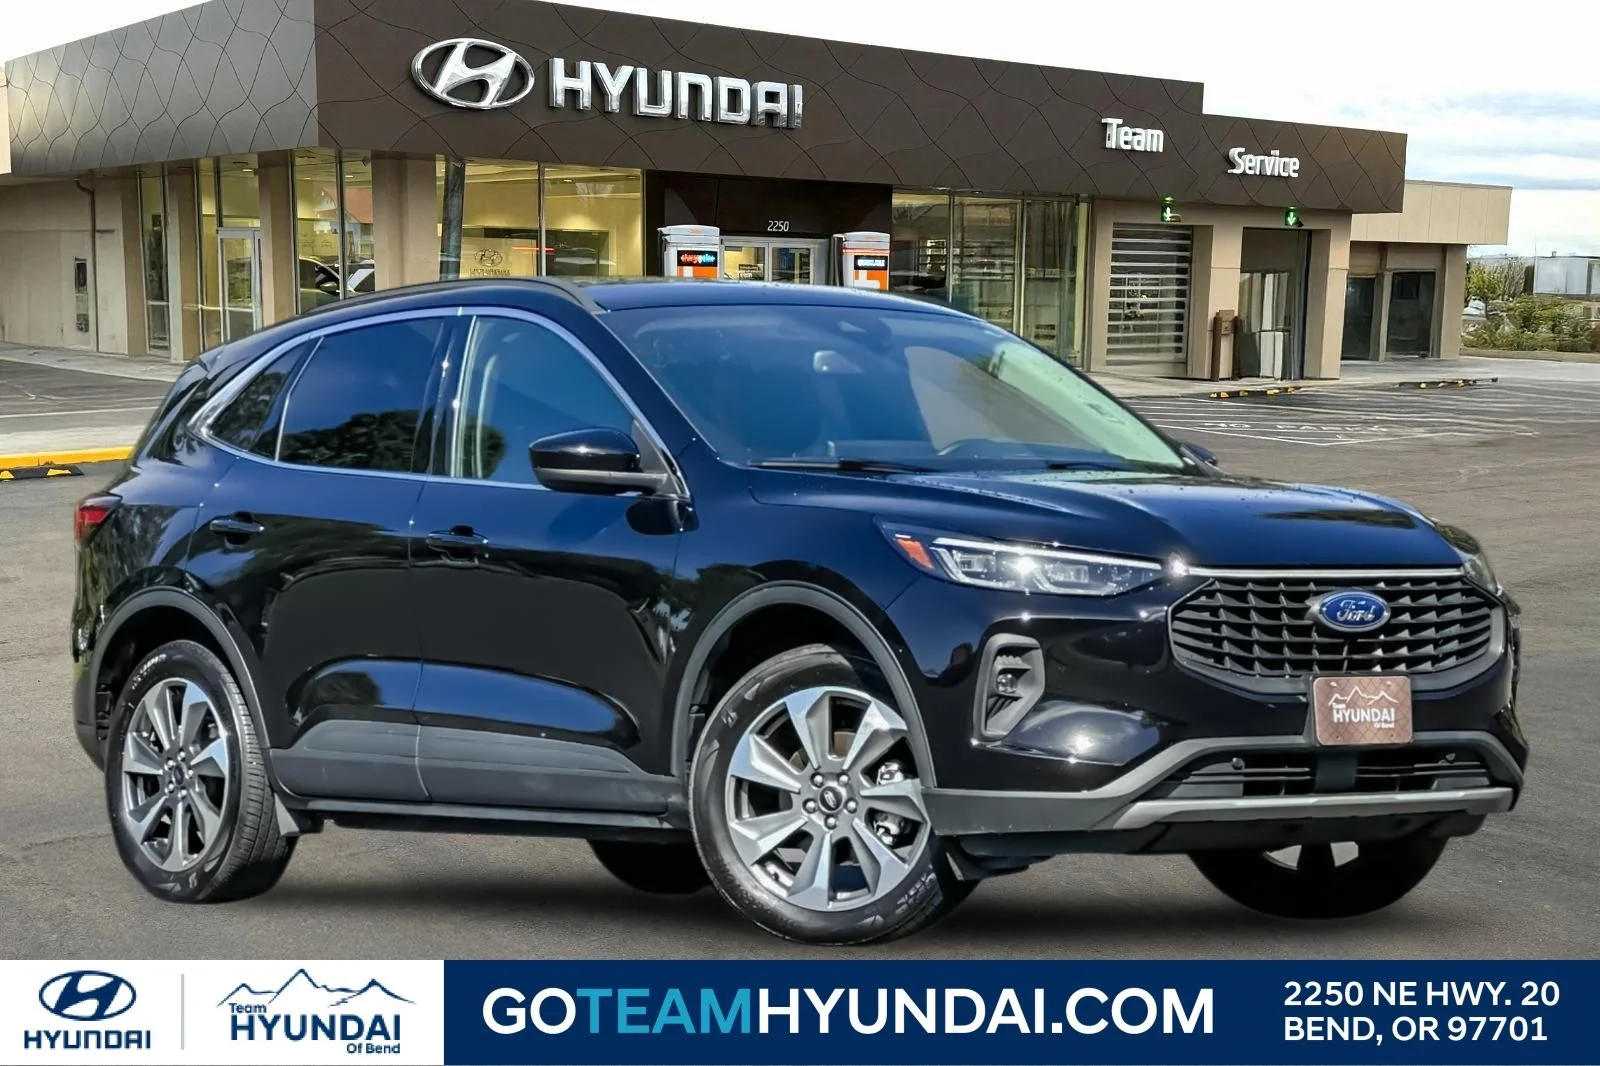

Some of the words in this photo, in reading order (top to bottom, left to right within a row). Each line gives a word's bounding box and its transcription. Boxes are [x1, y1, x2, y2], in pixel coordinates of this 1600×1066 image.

[549, 57, 803, 129] HYUNDAI
[1101, 117, 1164, 153] Team
[1227, 147, 1300, 178] Service
[767, 220, 790, 232] 2250
[1336, 600, 1376, 622] Ford
[1333, 708, 1396, 723] HYUNDAI
